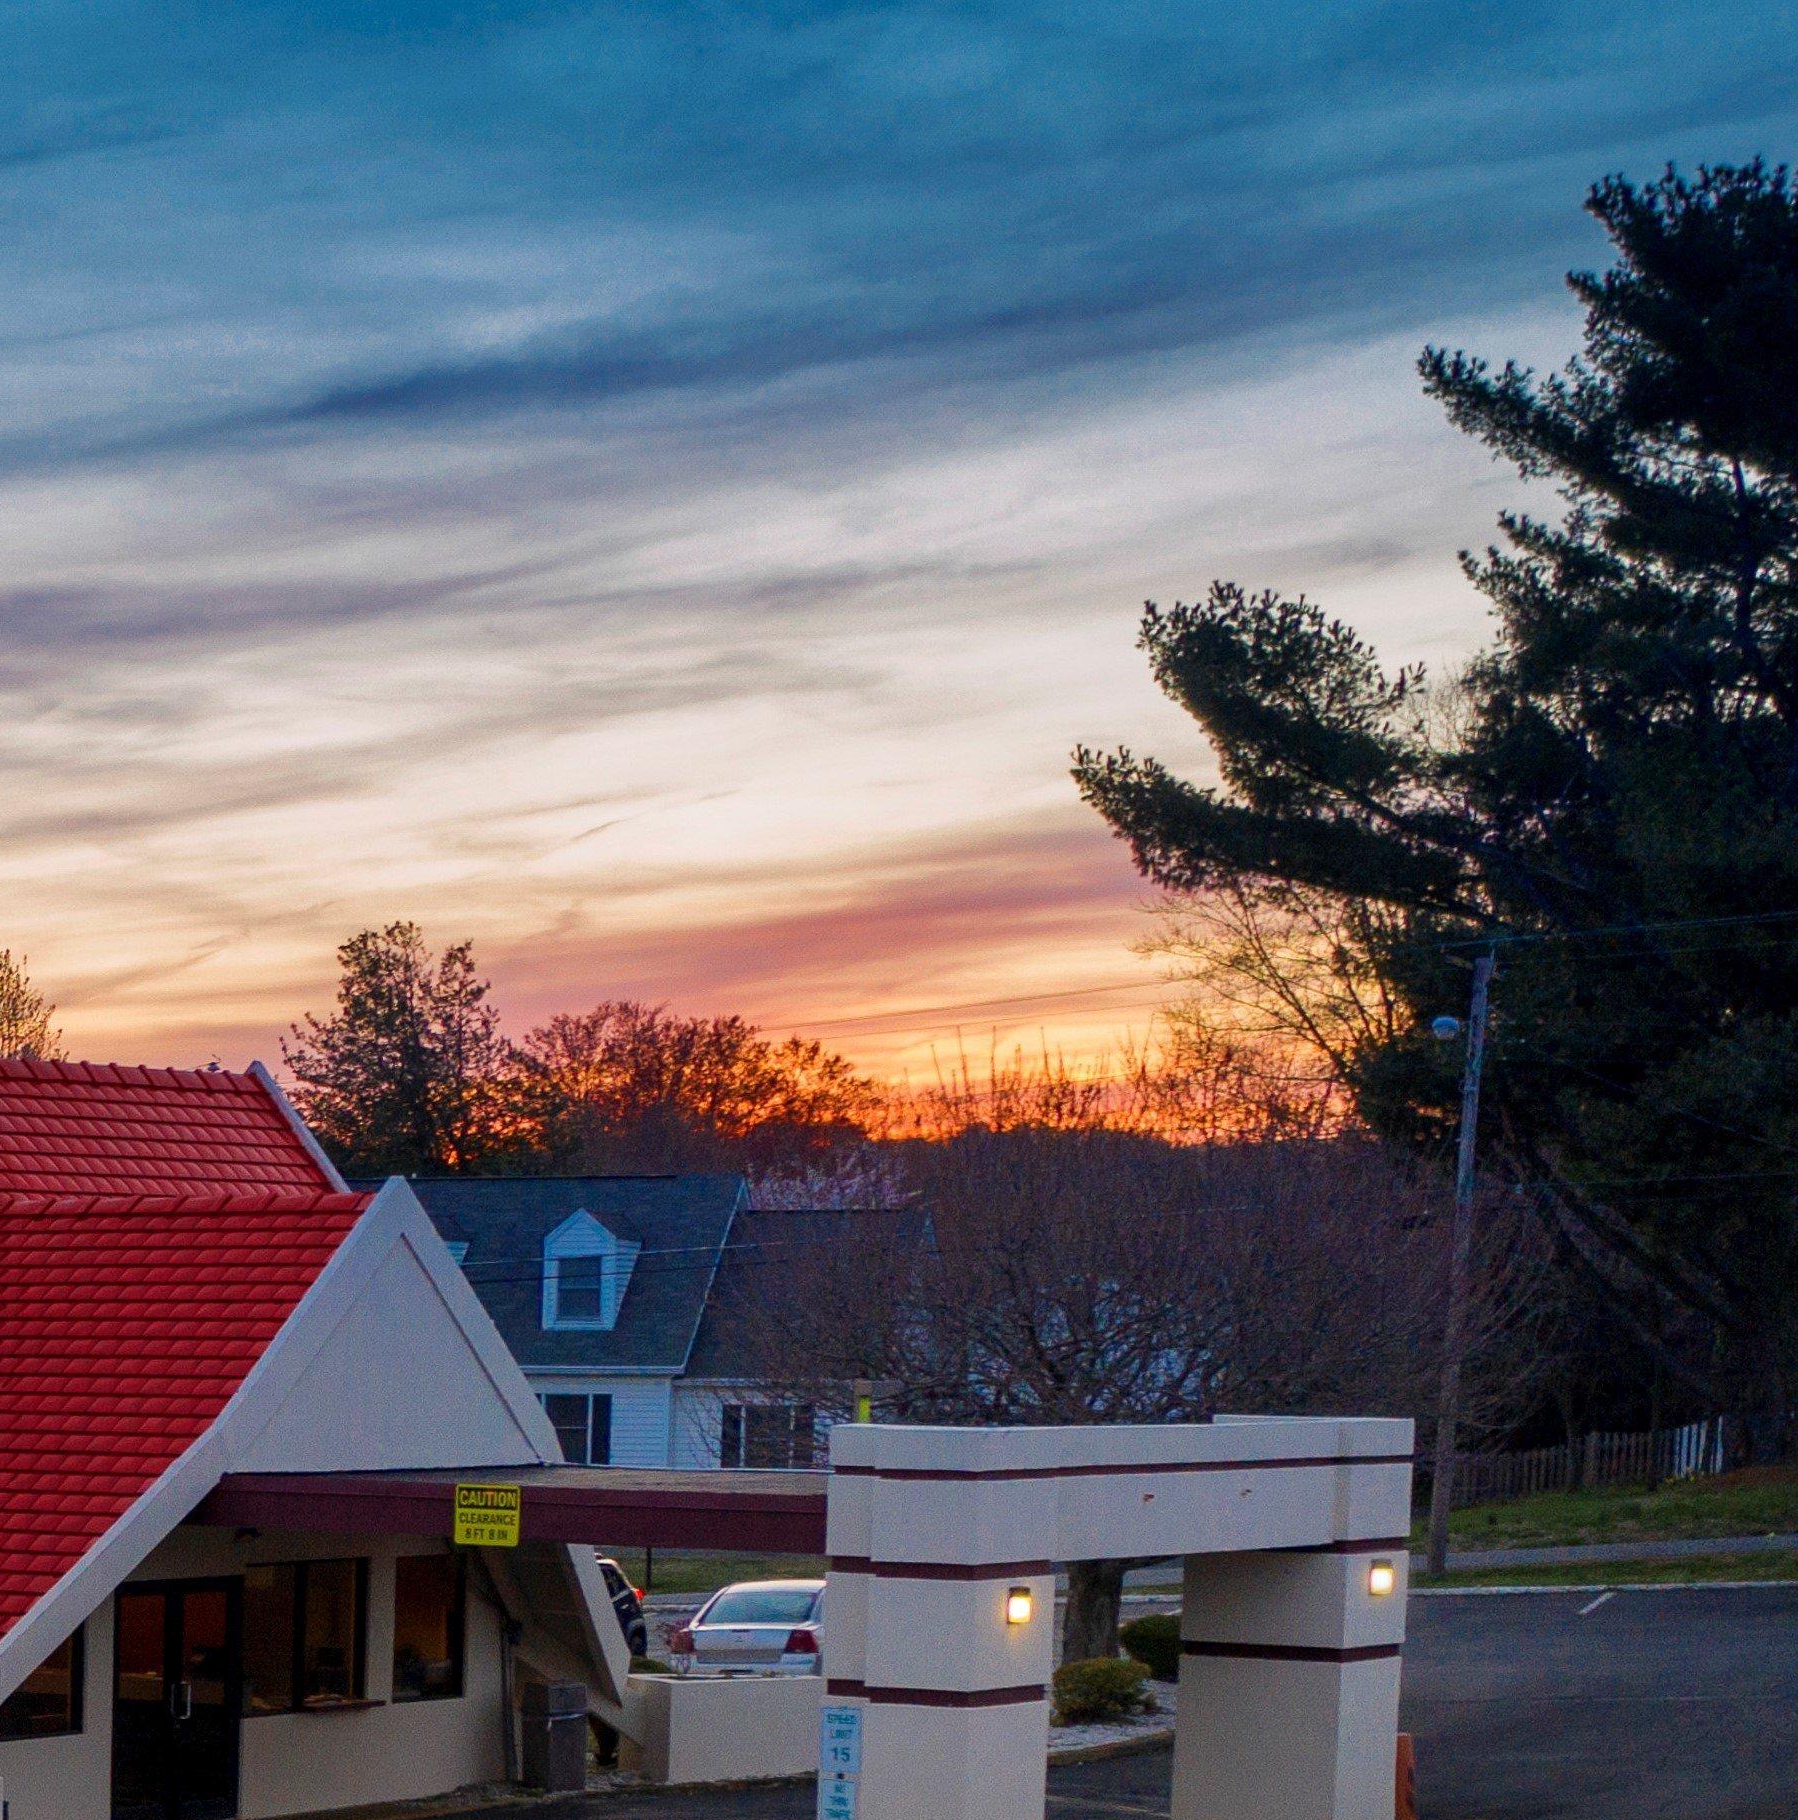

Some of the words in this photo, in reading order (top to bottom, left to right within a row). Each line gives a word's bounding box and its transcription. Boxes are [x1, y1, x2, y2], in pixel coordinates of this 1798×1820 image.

[460, 1489, 517, 1508] CAUTION
[459, 1512, 517, 1526] CLEARANCE
[474, 1528, 485, 1540] FT
[832, 1747, 851, 1763] 15
